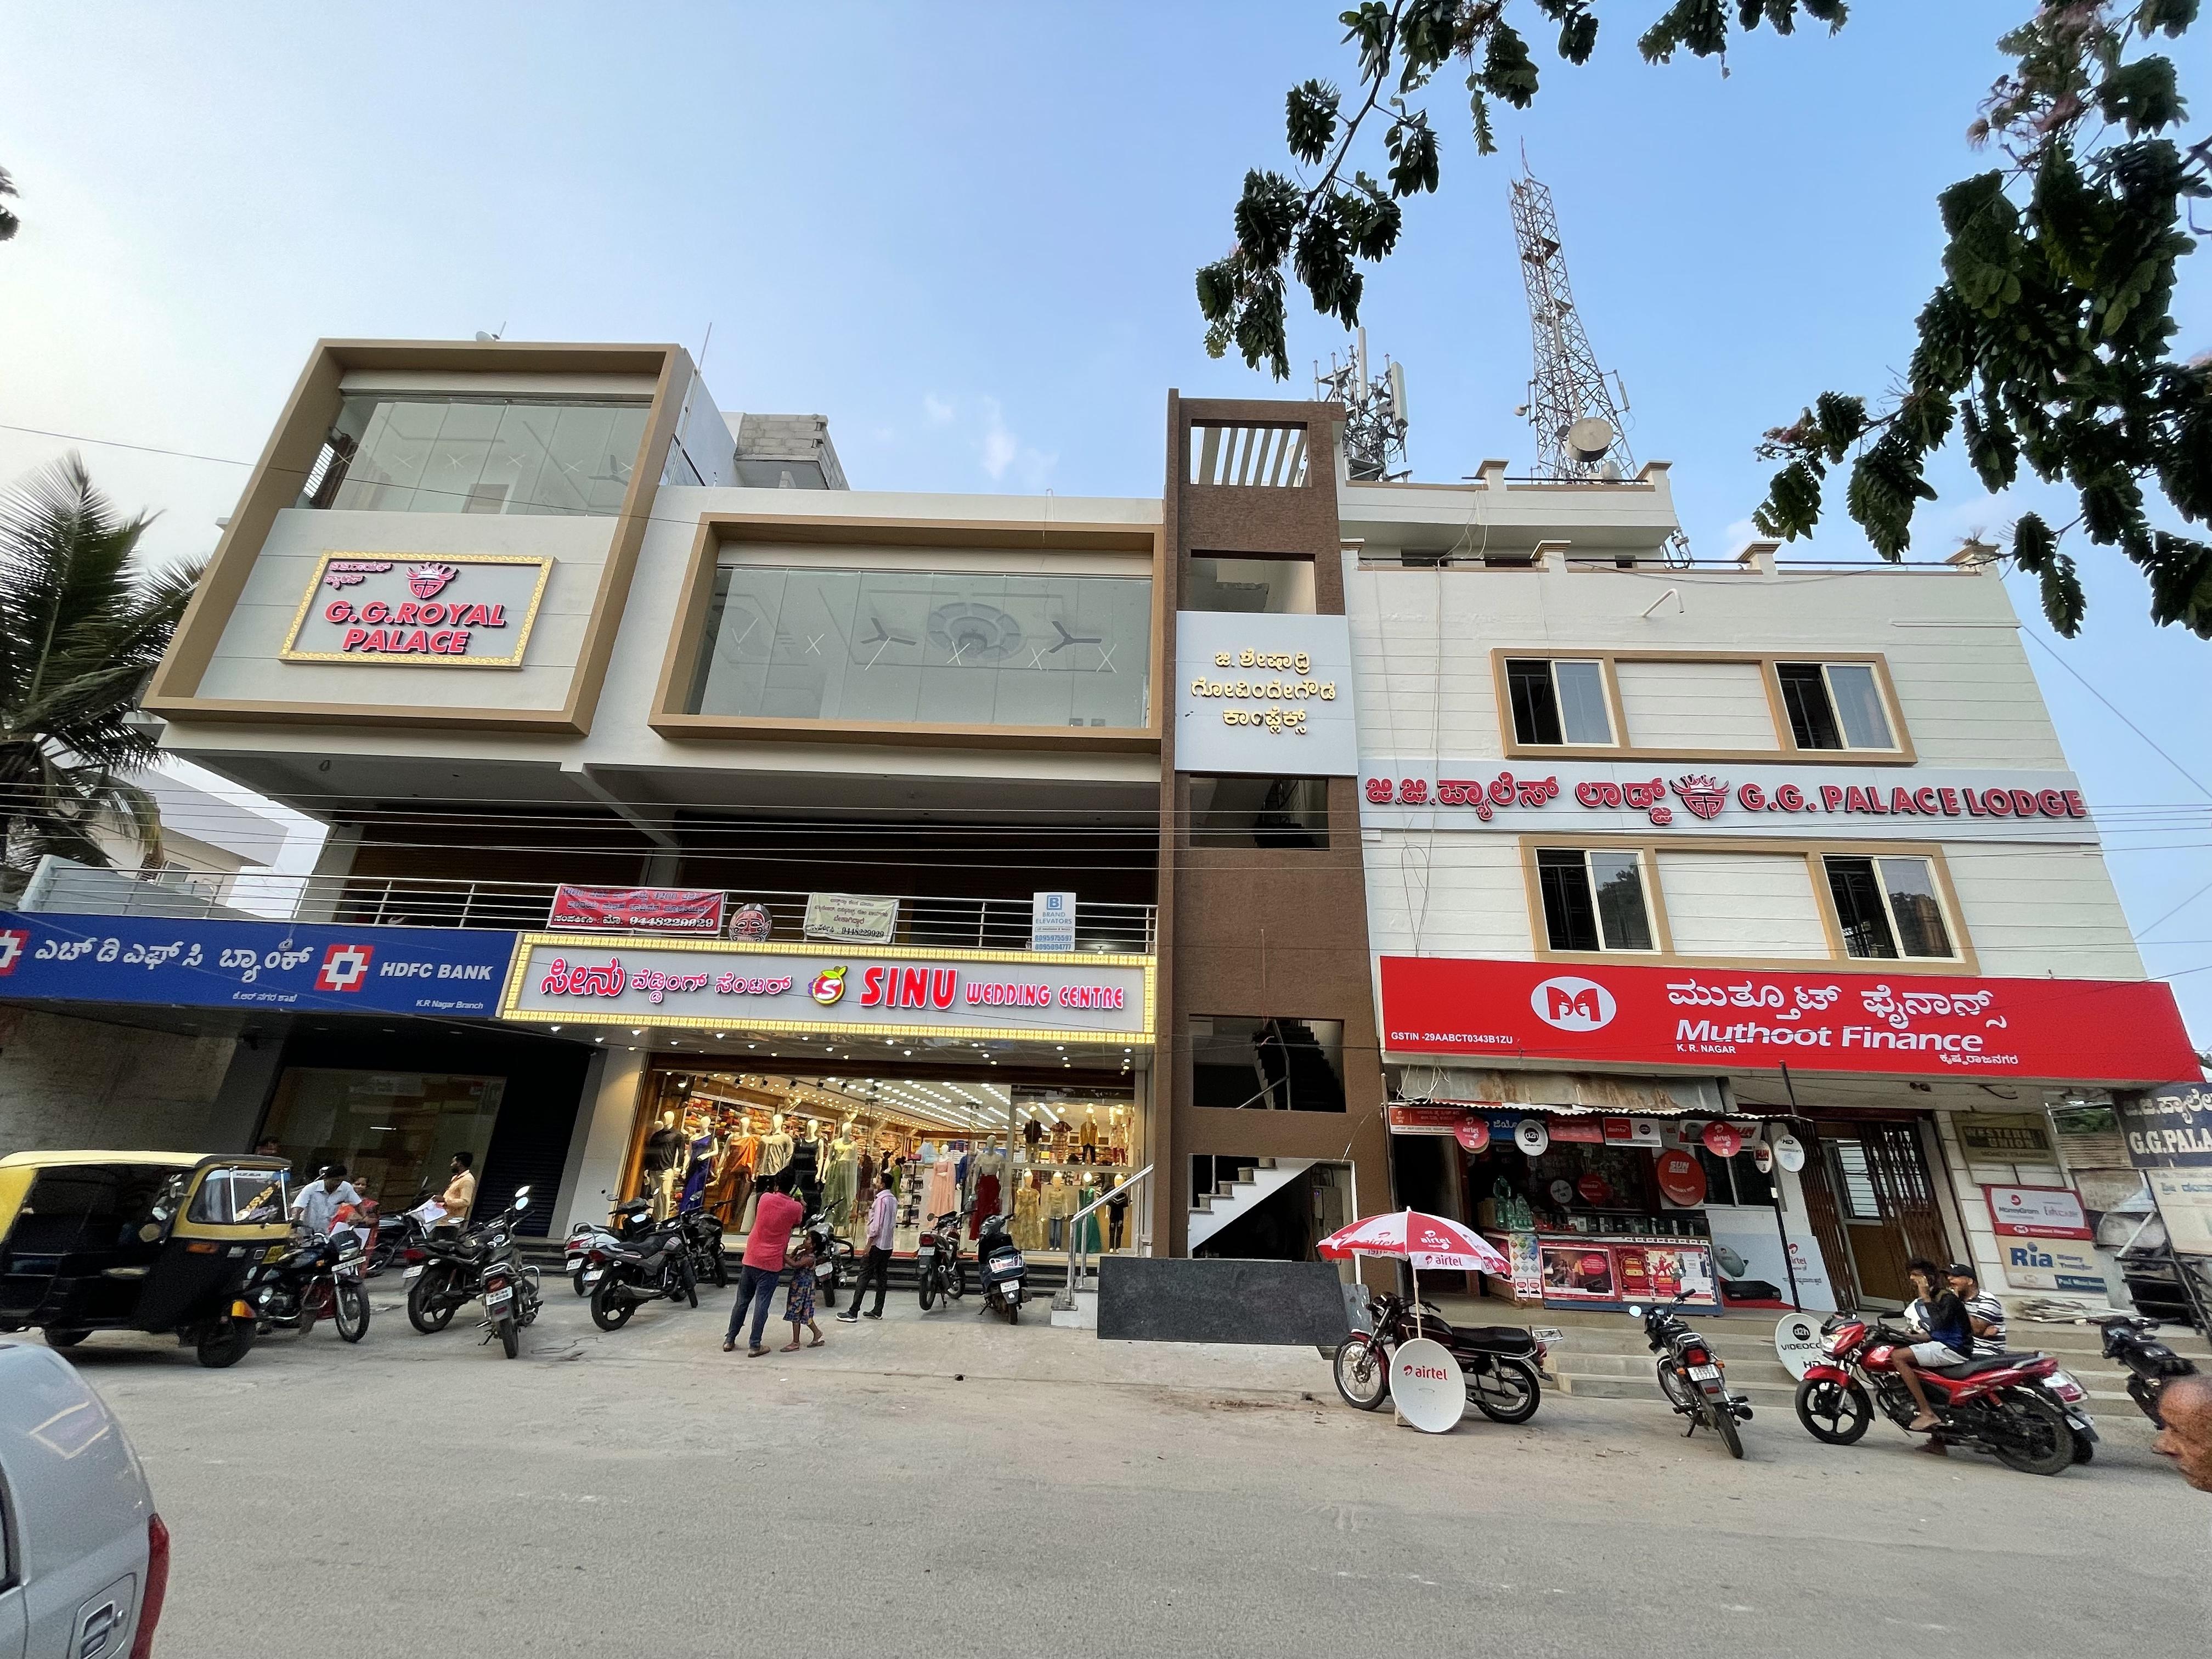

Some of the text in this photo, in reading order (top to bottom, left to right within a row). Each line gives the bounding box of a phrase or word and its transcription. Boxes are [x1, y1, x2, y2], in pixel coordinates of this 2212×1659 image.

[324, 601, 506, 627] G.G.ROYAL
[342, 628, 469, 653] PALACE
[1738, 783, 2086, 817] G.G. PALACE LODGE
[1049, 898, 1059, 907] B
[380, 962, 494, 980] HDFC BANK
[540, 957, 626, 997] ಸೀನು
[714, 972, 792, 995] ಸೆಂಟರ್
[859, 966, 1124, 1010] SINU WEDDING CENTRE
[431, 1000, 456, 1010] Nagar
[456, 1001, 483, 1009] Branch
[1391, 1031, 1419, 1041] GSTIN
[1676, 1019, 1984, 1053] Muthoot Finance
[1701, 1045, 1736, 1054] NAGAR
[1670, 1161, 1690, 1170] SUN
[1999, 1206, 2040, 1215] MoneyGram
[1420, 1237, 1452, 1245] airtel
[1435, 1254, 1463, 1267] airtel
[1790, 1256, 1807, 1265] irtel
[2010, 1242, 2054, 1268] Ria
[1794, 1327, 1809, 1336] d2h
[1415, 1365, 1448, 1381] airtel
